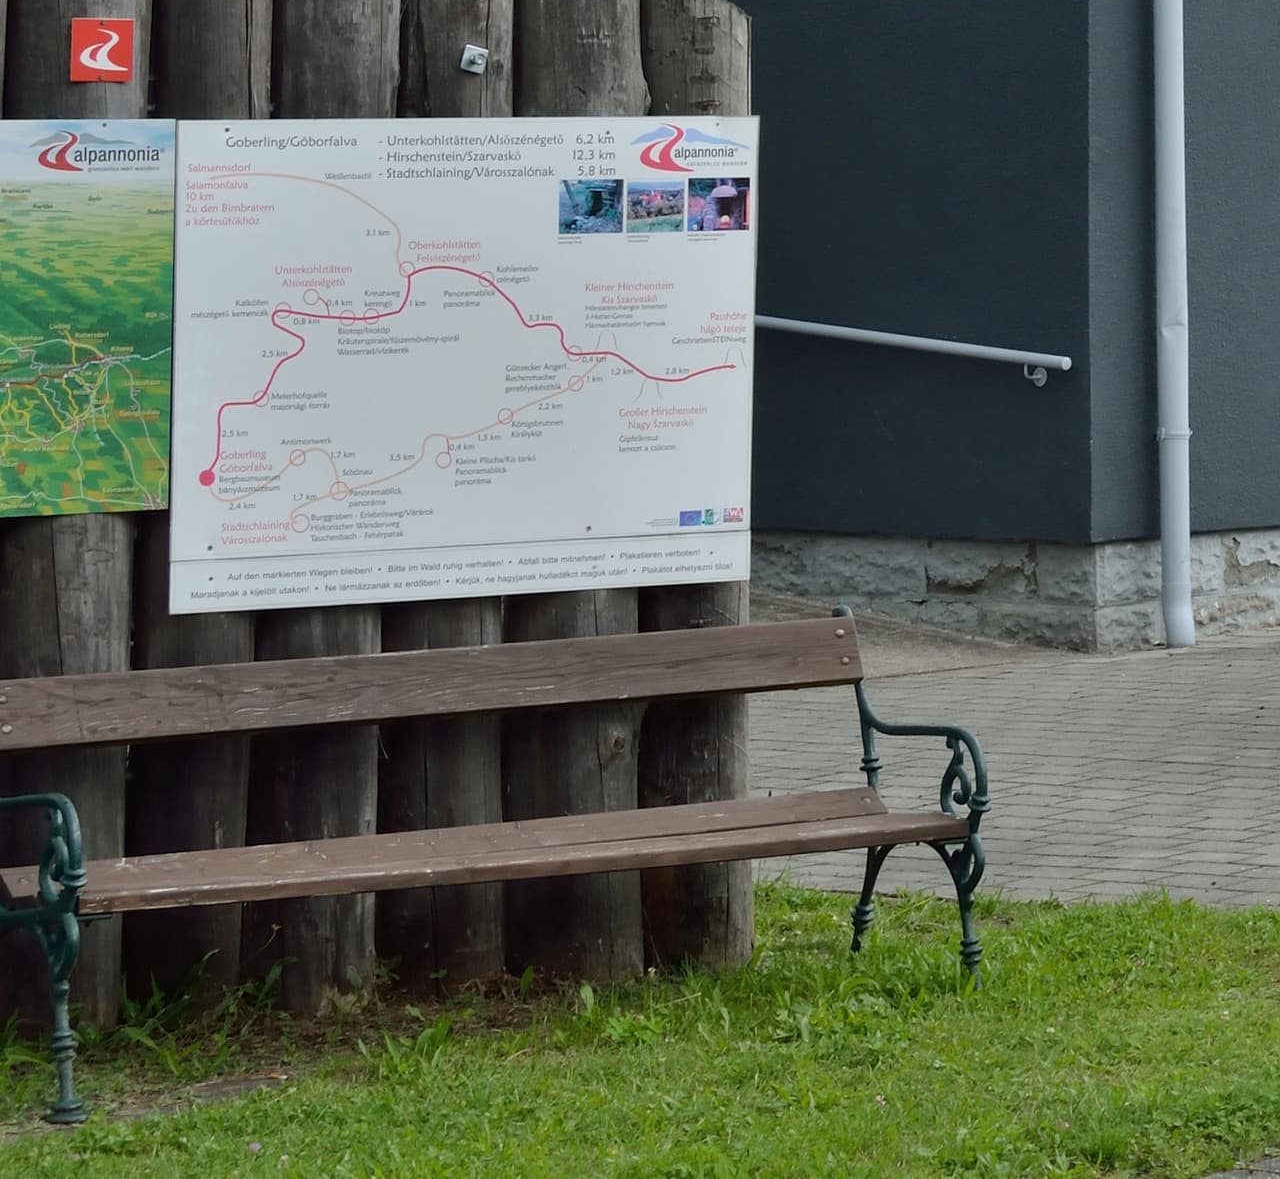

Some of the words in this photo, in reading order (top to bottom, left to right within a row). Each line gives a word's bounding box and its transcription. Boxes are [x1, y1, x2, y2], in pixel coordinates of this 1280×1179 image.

[225, 135, 358, 150] Goberling/Góborfalva
[598, 133, 615, 144] km
[599, 149, 616, 161] km
[599, 165, 616, 176] km
[199, 192, 215, 201] km
[185, 204, 198, 213] Zu
[201, 204, 218, 213] den
[378, 229, 391, 237] km
[276, 349, 289, 358] km
[236, 429, 249, 437] km
[220, 450, 267, 461] Goberling
[403, 453, 416, 461] km
[243, 501, 256, 510] km
[227, 572, 242, 581] Auf
[244, 572, 260, 581] den
[309, 568, 338, 579] Wegen
[325, 583, 337, 592] Ne
